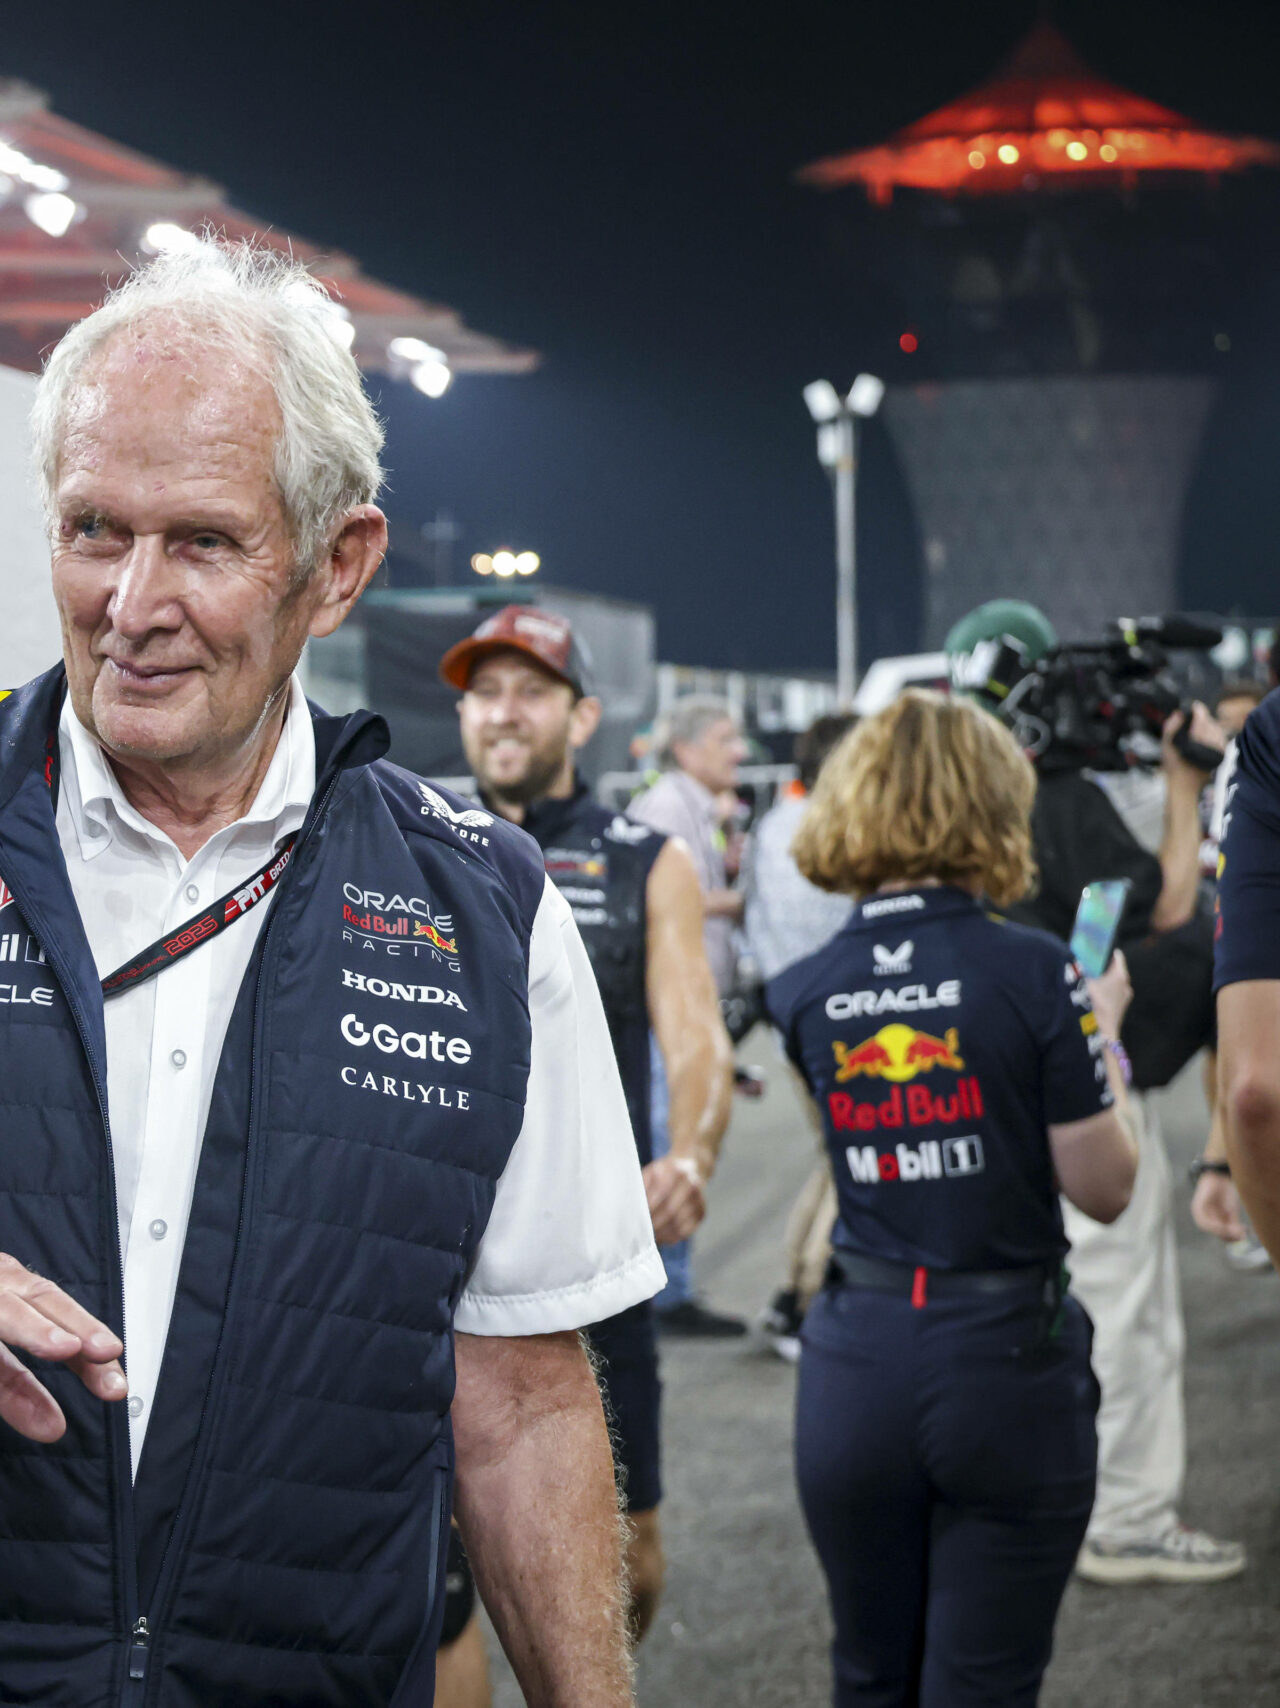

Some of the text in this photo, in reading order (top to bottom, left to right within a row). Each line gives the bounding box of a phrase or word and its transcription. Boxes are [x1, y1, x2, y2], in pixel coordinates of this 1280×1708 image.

[420, 806, 489, 847] CATORE
[163, 915, 218, 956] 2025
[233, 874, 266, 912] PIT
[342, 882, 455, 932] ORACLE
[342, 904, 409, 935] Red Bull
[342, 930, 461, 973] RACING
[342, 968, 468, 1012] HONDA
[825, 980, 962, 1020] ORACLE
[340, 1066, 470, 1111] CARLYLE
[828, 1076, 984, 1132] Red Bull
[846, 1140, 942, 1184] Mobil
